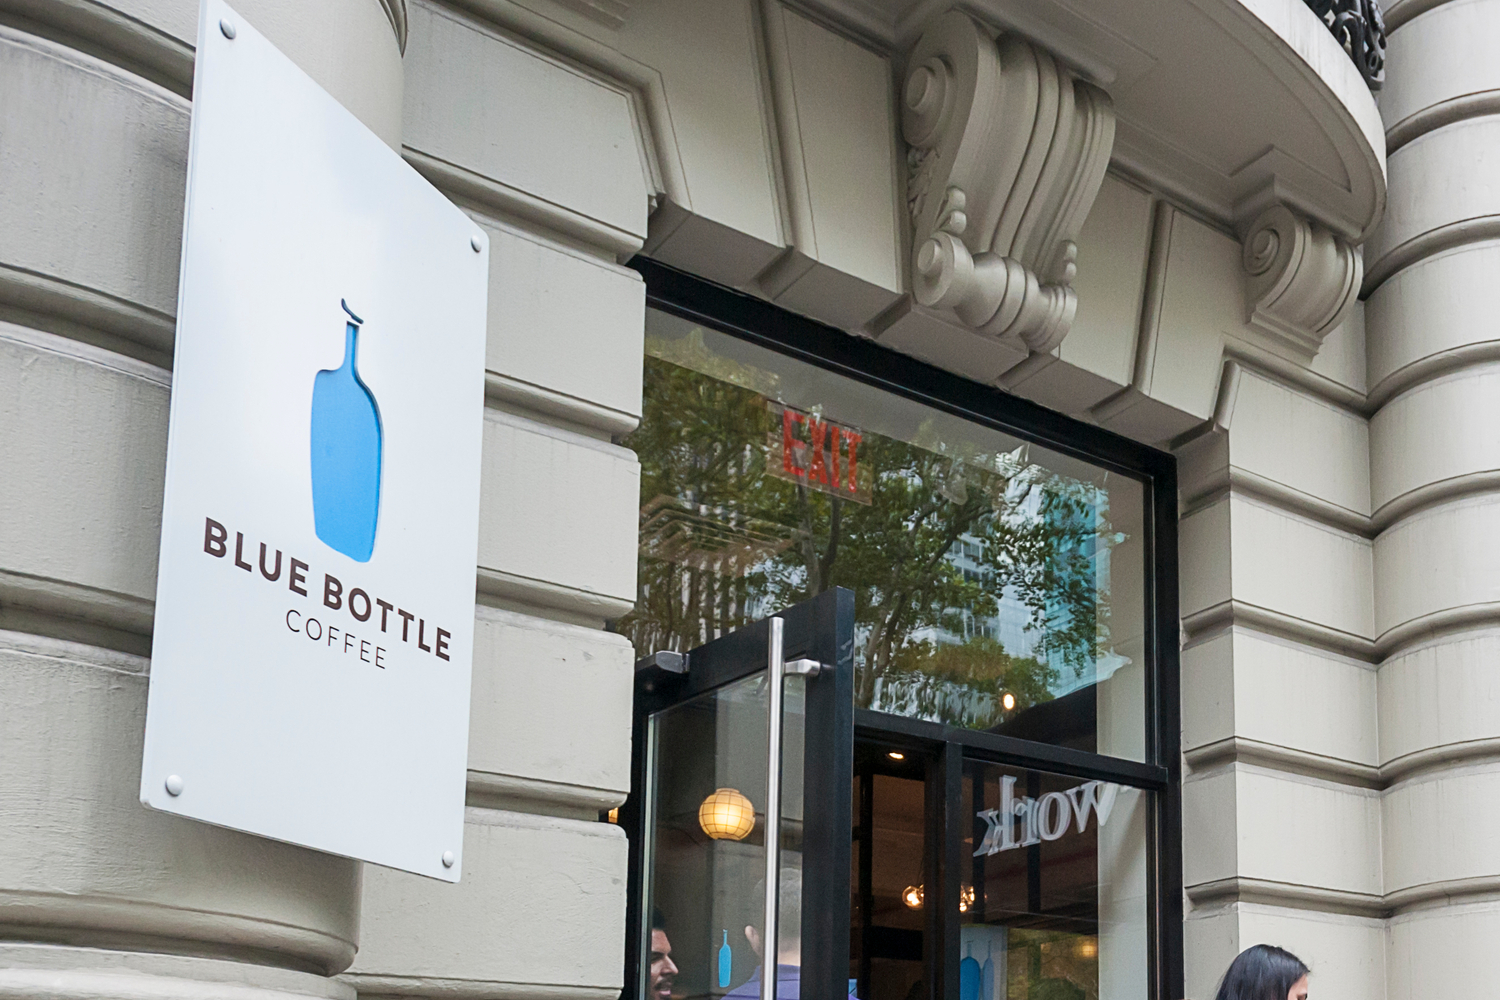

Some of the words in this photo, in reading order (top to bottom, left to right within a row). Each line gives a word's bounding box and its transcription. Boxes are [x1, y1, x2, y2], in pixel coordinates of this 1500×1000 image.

[783, 409, 862, 493] EXIT
[203, 516, 309, 598] BLUE
[323, 572, 452, 662] BOTTLE
[286, 609, 387, 670] COFFEE
